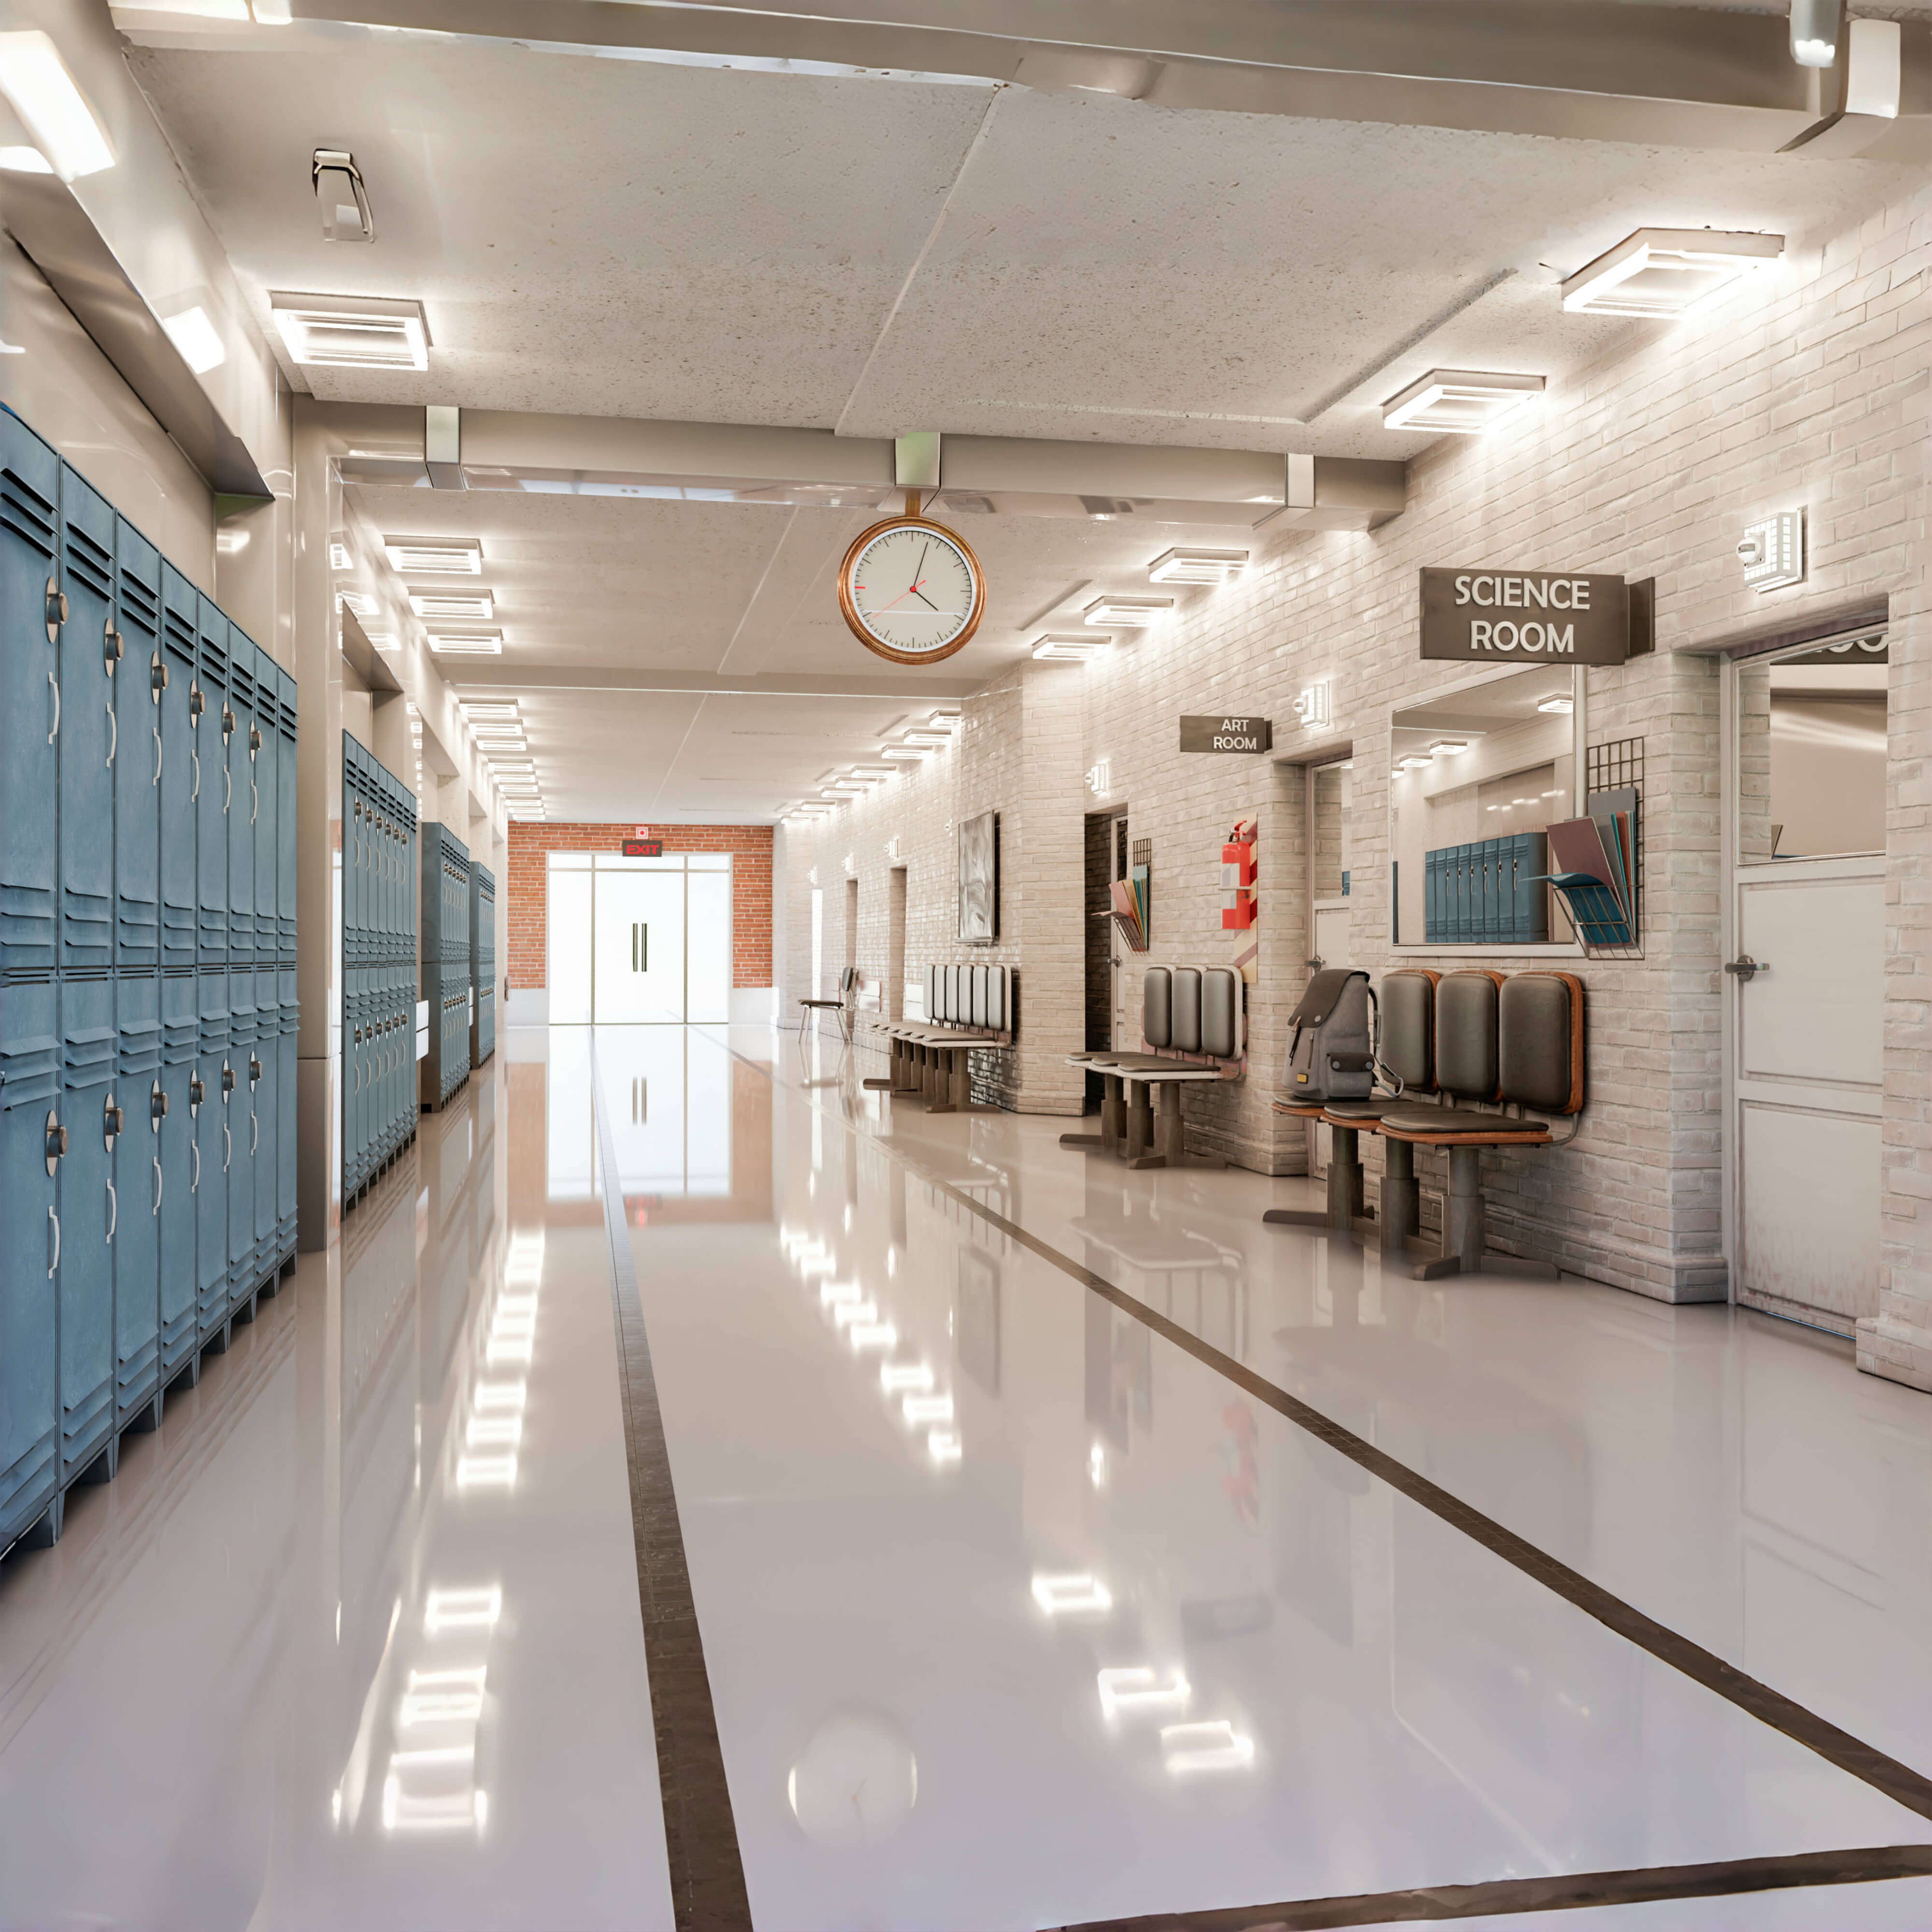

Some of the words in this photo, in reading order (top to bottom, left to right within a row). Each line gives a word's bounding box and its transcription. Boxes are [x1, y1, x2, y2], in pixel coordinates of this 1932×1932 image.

[1455, 575, 1590, 610] SCIENCE
[1470, 620, 1574, 653] ROOM
[1221, 719, 1249, 732] ART
[1213, 736, 1257, 750] ROOM
[626, 845, 659, 854] EXIT
